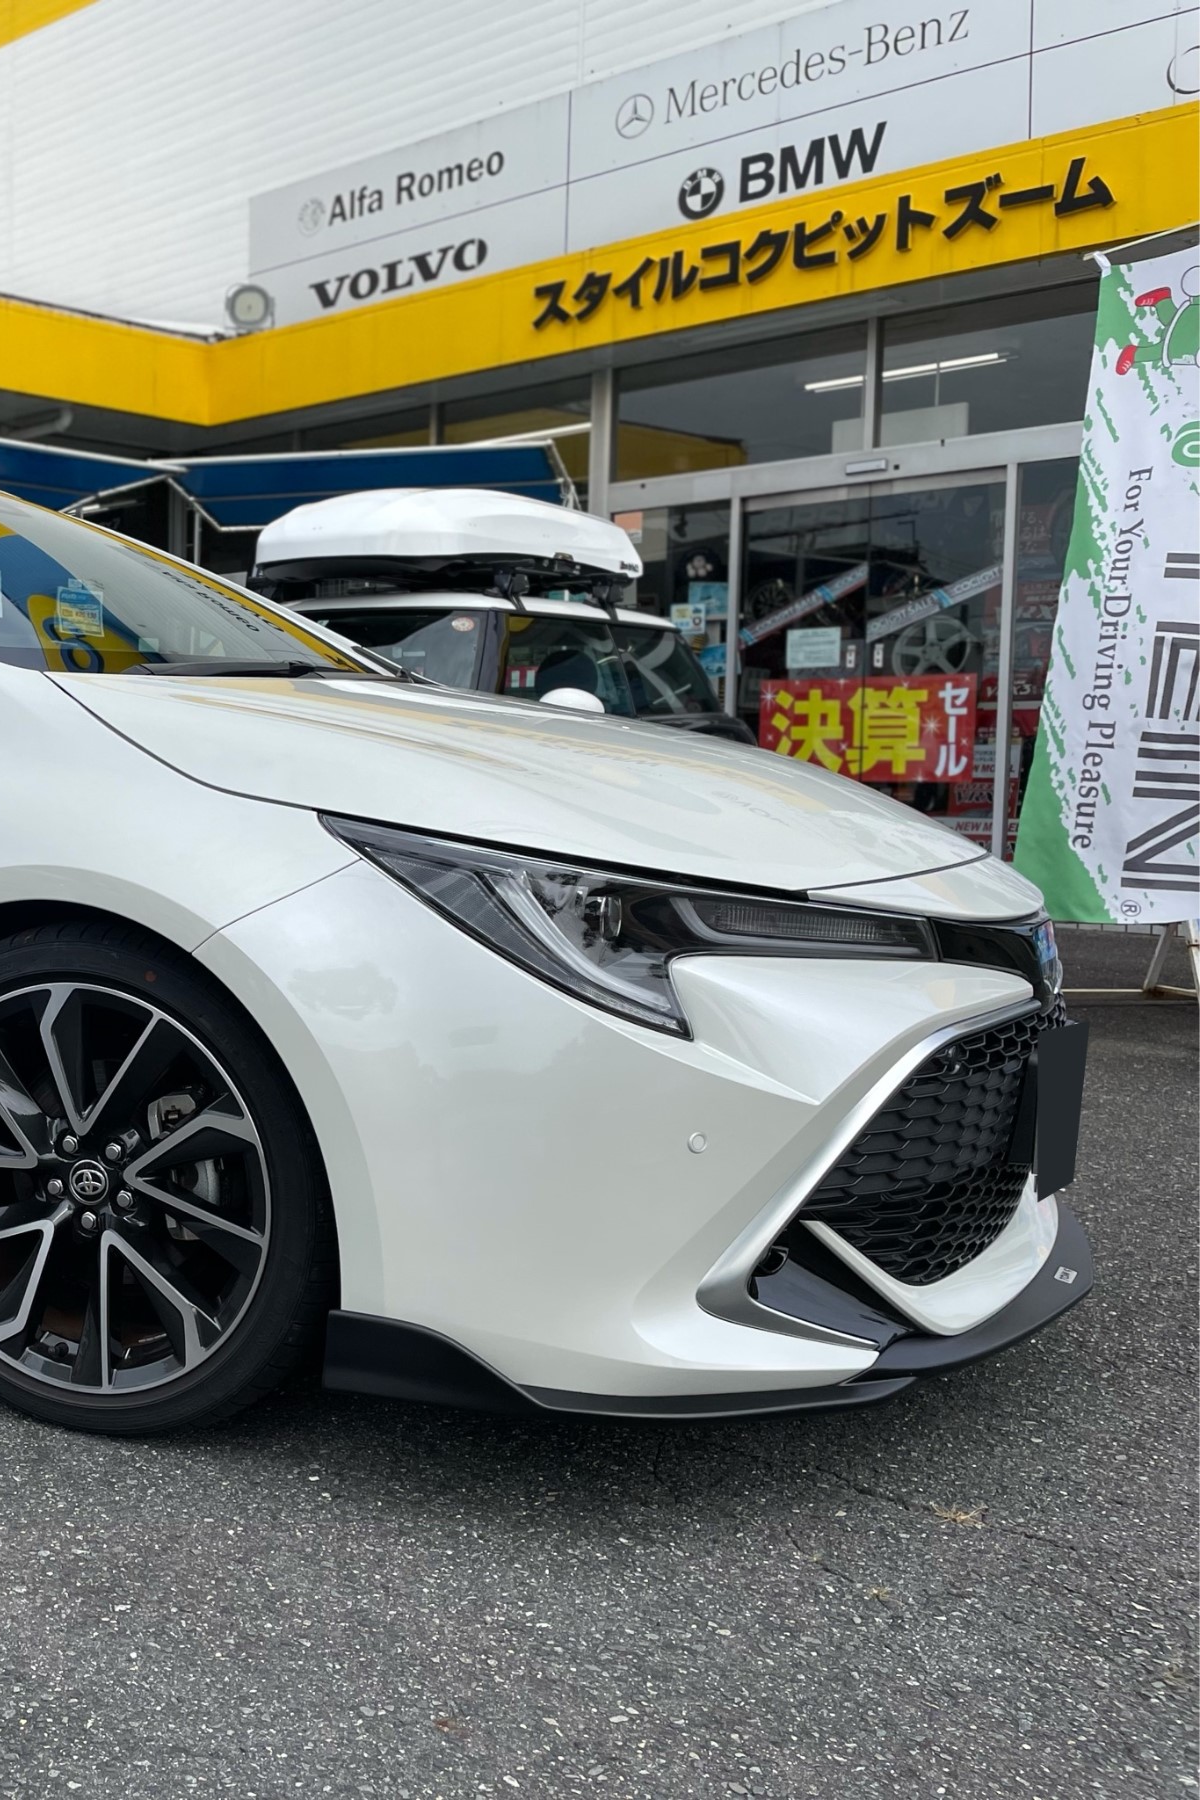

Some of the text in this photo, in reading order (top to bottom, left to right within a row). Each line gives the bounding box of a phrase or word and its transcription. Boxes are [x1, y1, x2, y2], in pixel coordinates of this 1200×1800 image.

[664, 9, 970, 124] Mercedes-Benz
[327, 185, 383, 227] Alfa
[395, 151, 505, 205] Romeo
[739, 121, 887, 203] BMW
[308, 238, 488, 310] VOLVO
[532, 156, 1118, 331] スタイルコクピットズーム
[1072, 466, 1153, 850] For Your Driving Pleasure
[771, 686, 928, 775] 決算
[934, 681, 970, 777] セール
[955, 820, 982, 832] NEW
